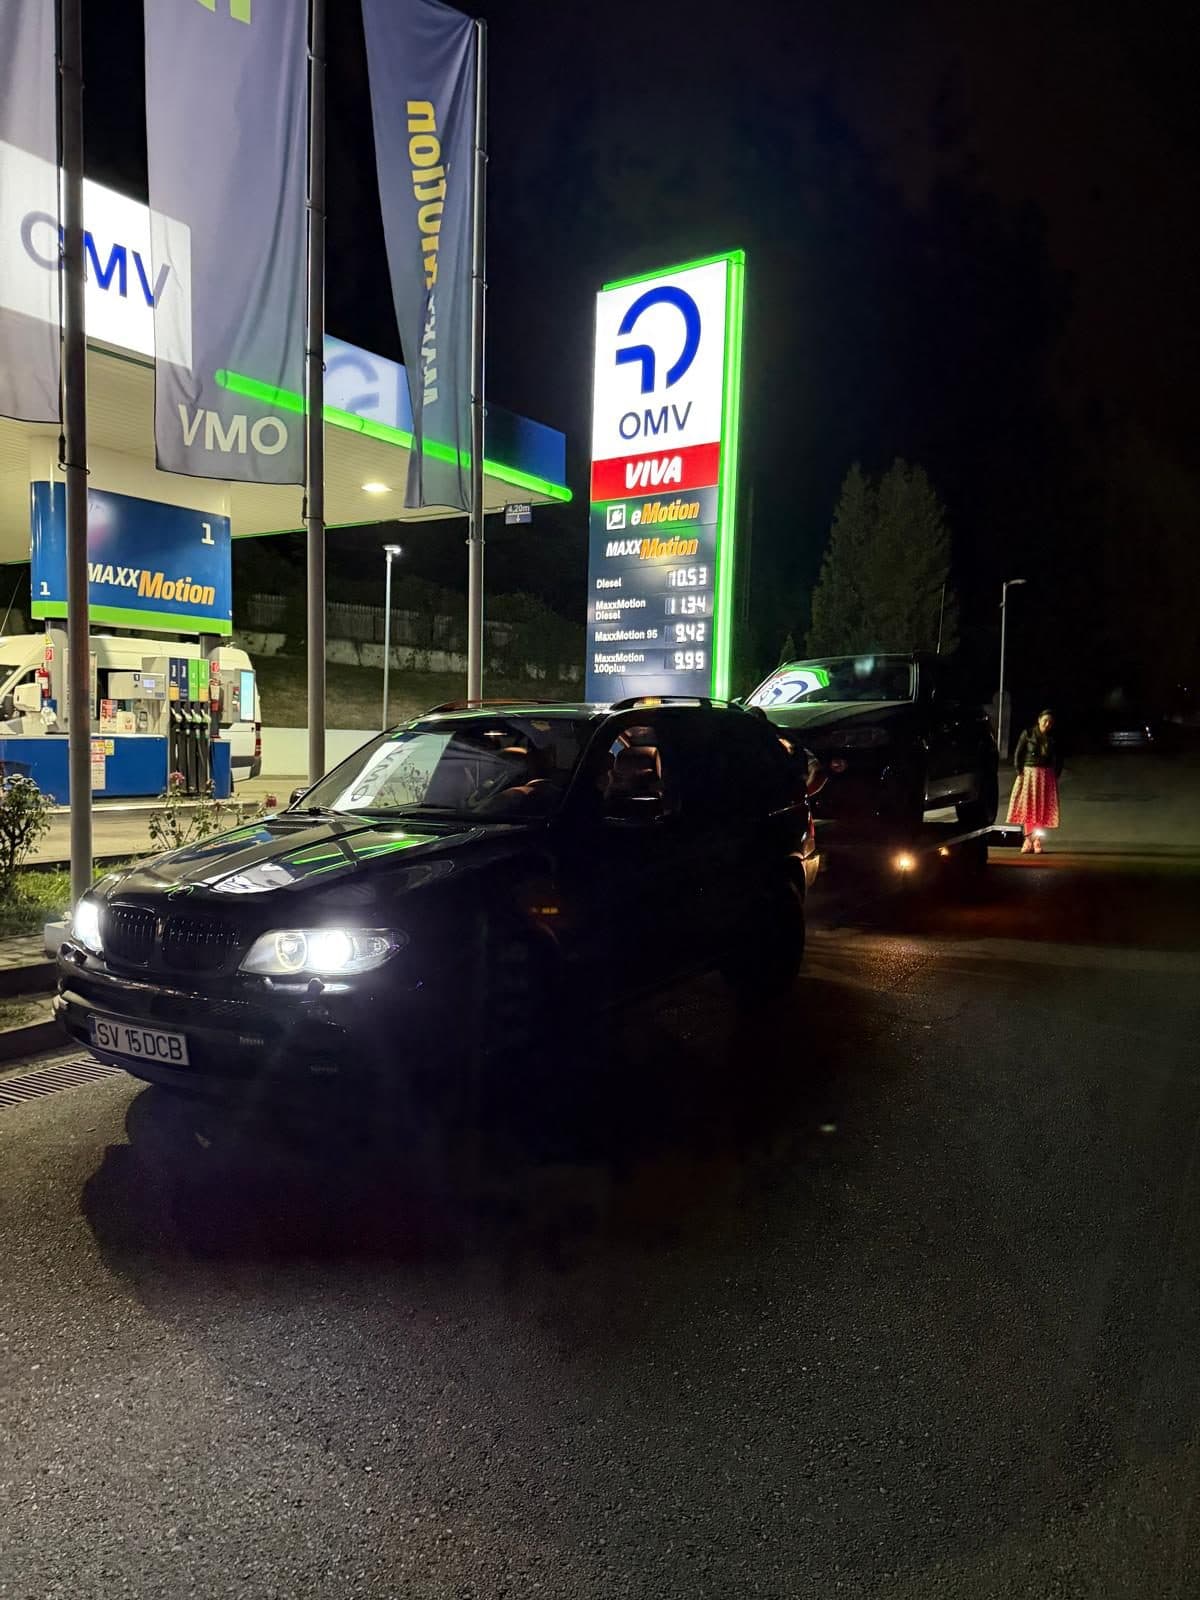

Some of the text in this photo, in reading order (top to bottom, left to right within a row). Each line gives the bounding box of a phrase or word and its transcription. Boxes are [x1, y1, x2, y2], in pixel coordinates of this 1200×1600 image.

[20, 211, 171, 309] OMV
[618, 401, 693, 440] OMV
[625, 455, 683, 490] VIVA
[630, 499, 700, 526] eMotion
[201, 522, 215, 546] 1
[605, 536, 699, 560] MAXXMotion
[39, 581, 51, 596] 1
[596, 577, 622, 589] Diesel
[595, 598, 646, 611] MaxxMotion
[595, 610, 621, 621] Diesel
[594, 629, 645, 642] MaxxMotion
[646, 629, 658, 639] 95
[594, 652, 645, 663] MaxxMotion
[594, 663, 626, 675] 100plus
[97, 1023, 119, 1049] SV
